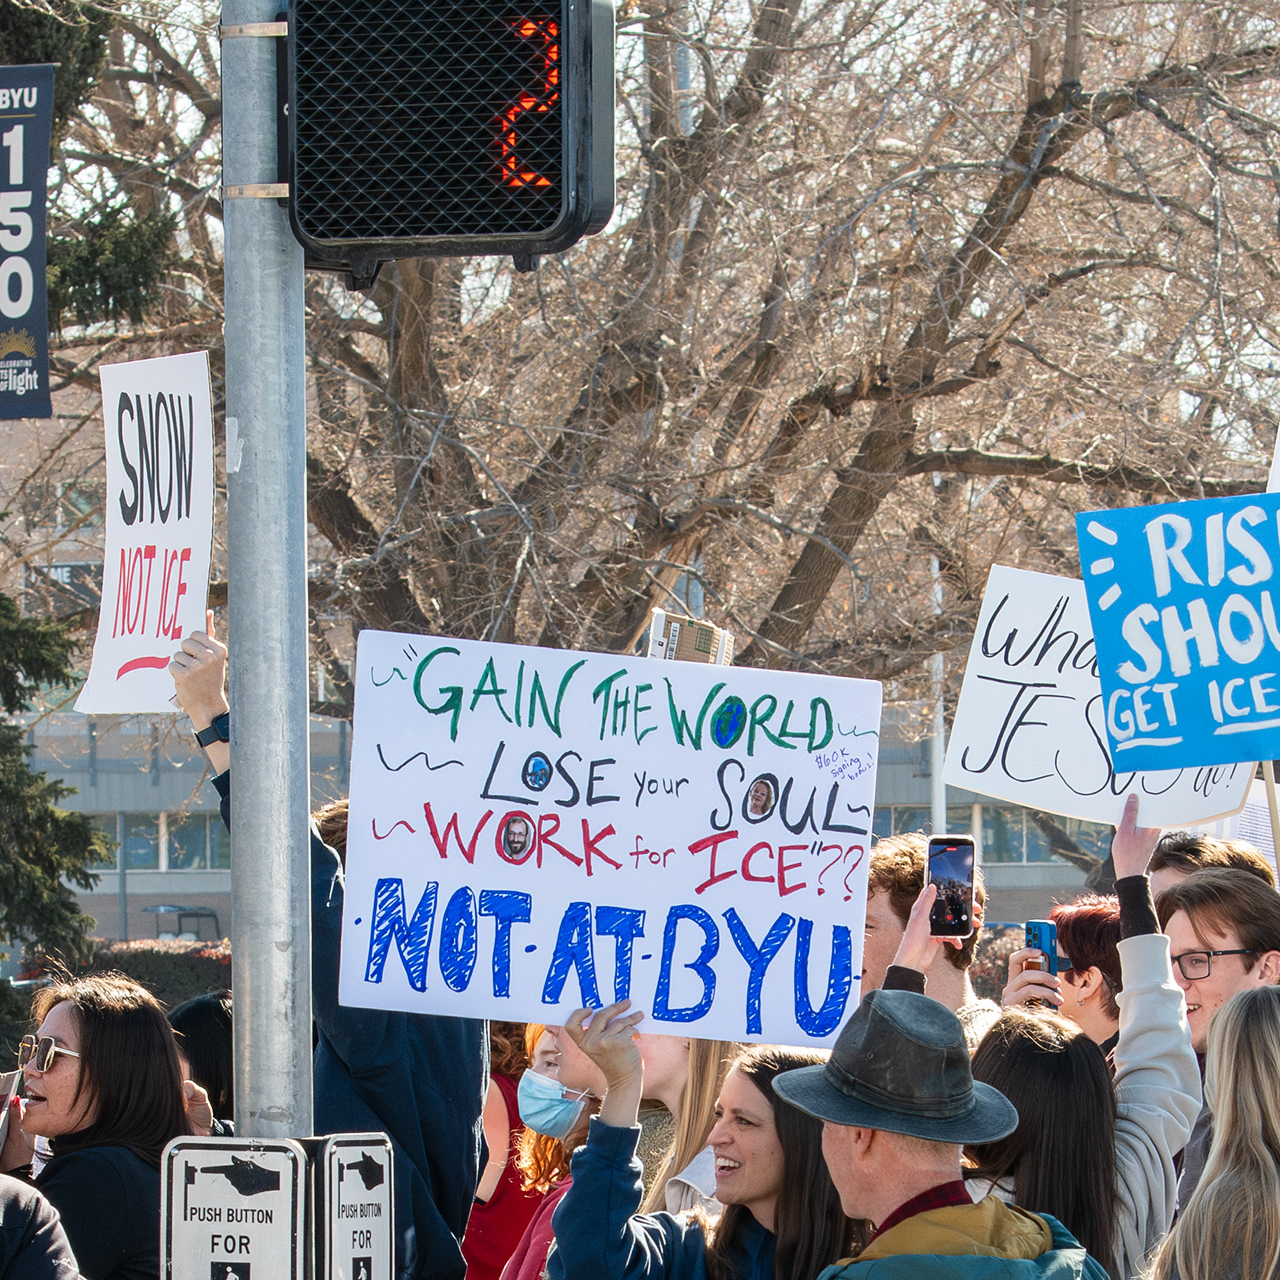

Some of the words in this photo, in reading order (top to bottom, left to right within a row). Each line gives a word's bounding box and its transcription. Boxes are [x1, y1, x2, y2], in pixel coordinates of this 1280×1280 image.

[0, 381, 8, 391] OF
[8, 368, 38, 395] light
[117, 392, 195, 525] SNOW
[112, 545, 157, 640] NOT
[160, 547, 191, 642] ICE
[593, 669, 658, 746] THE
[663, 676, 833, 756] WORLD
[1106, 683, 1179, 741] GET
[815, 747, 850, 770] $60K
[831, 757, 861, 779] signing
[480, 741, 620, 807] LOSE
[633, 769, 690, 807] your
[710, 758, 868, 836] SOUL
[423, 801, 622, 877] WORK
[630, 835, 677, 871] for
[363, 877, 532, 999] NOT
[542, 902, 646, 1009] AT
[651, 904, 853, 1038] BYU
[189, 1207, 222, 1223] PUSH
[226, 1208, 273, 1224] BUTTON
[341, 1204, 358, 1219] PUSH
[359, 1203, 382, 1218] BUTTON
[211, 1235, 251, 1254] FOR
[352, 1230, 372, 1249] FOR
